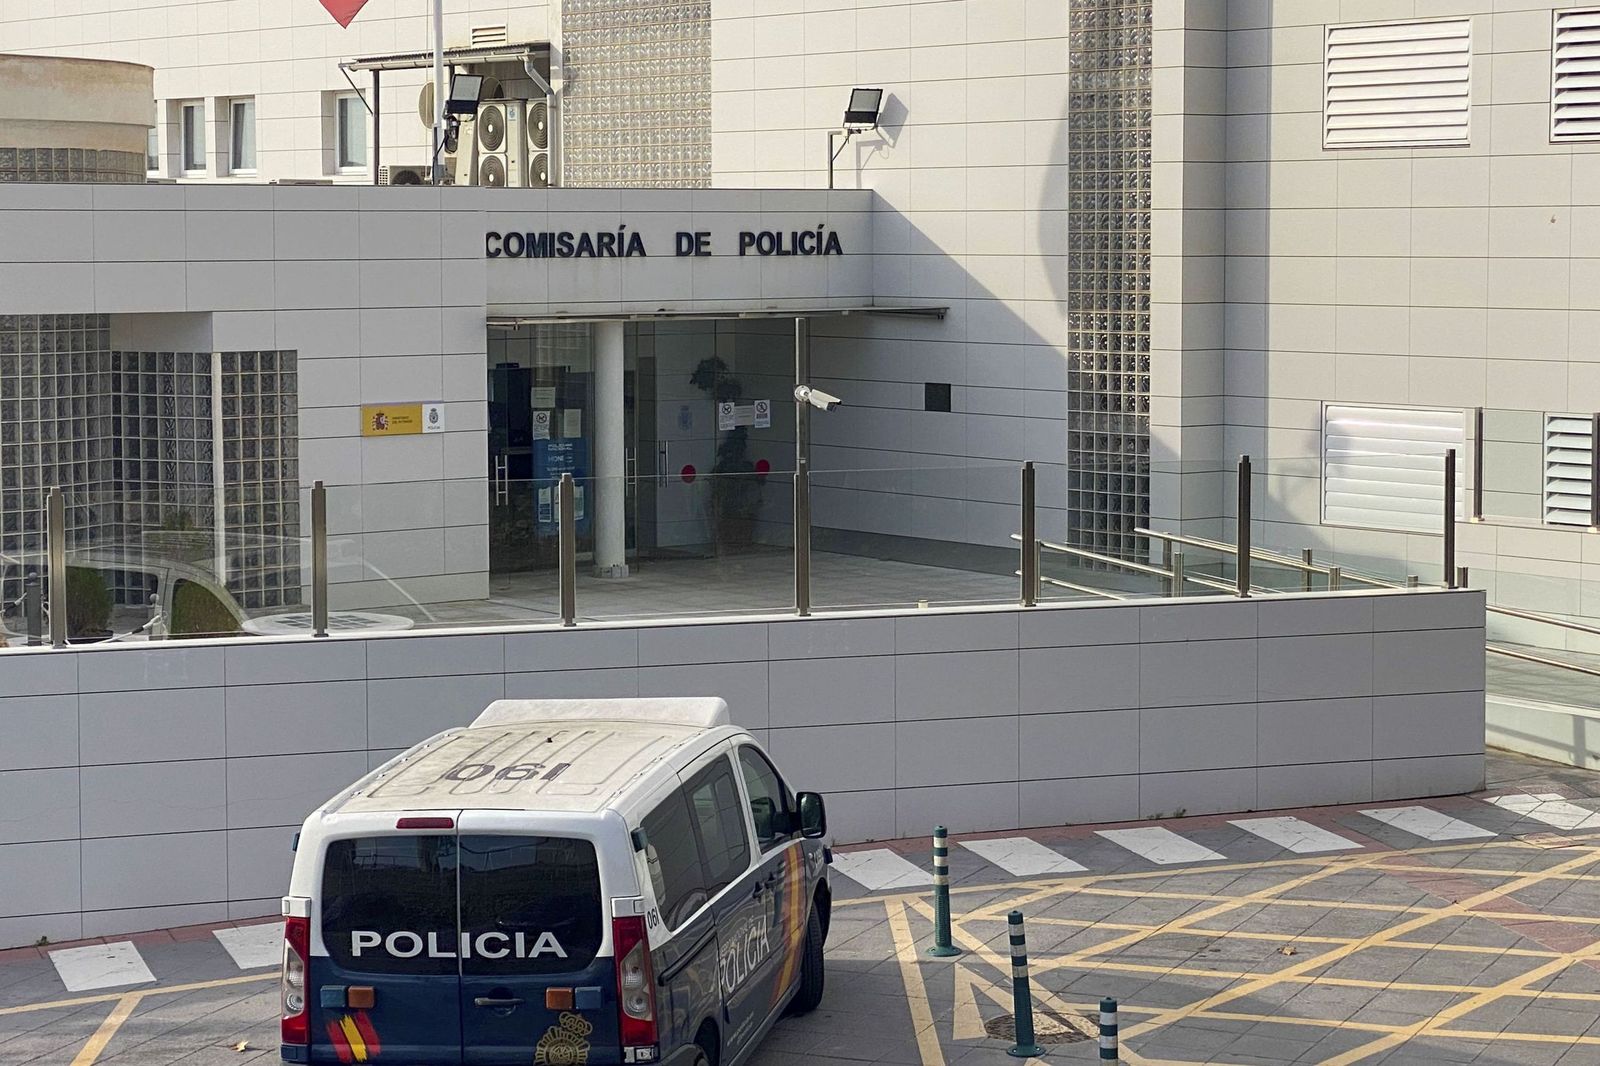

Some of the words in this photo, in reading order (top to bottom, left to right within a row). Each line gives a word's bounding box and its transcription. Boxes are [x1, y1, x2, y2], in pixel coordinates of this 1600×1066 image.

[485, 224, 647, 258] COMISARÍA
[676, 231, 711, 257] DE
[739, 223, 843, 257] POLICÍA
[351, 930, 568, 958] POLICIA
[716, 914, 770, 1000] POLICIA
